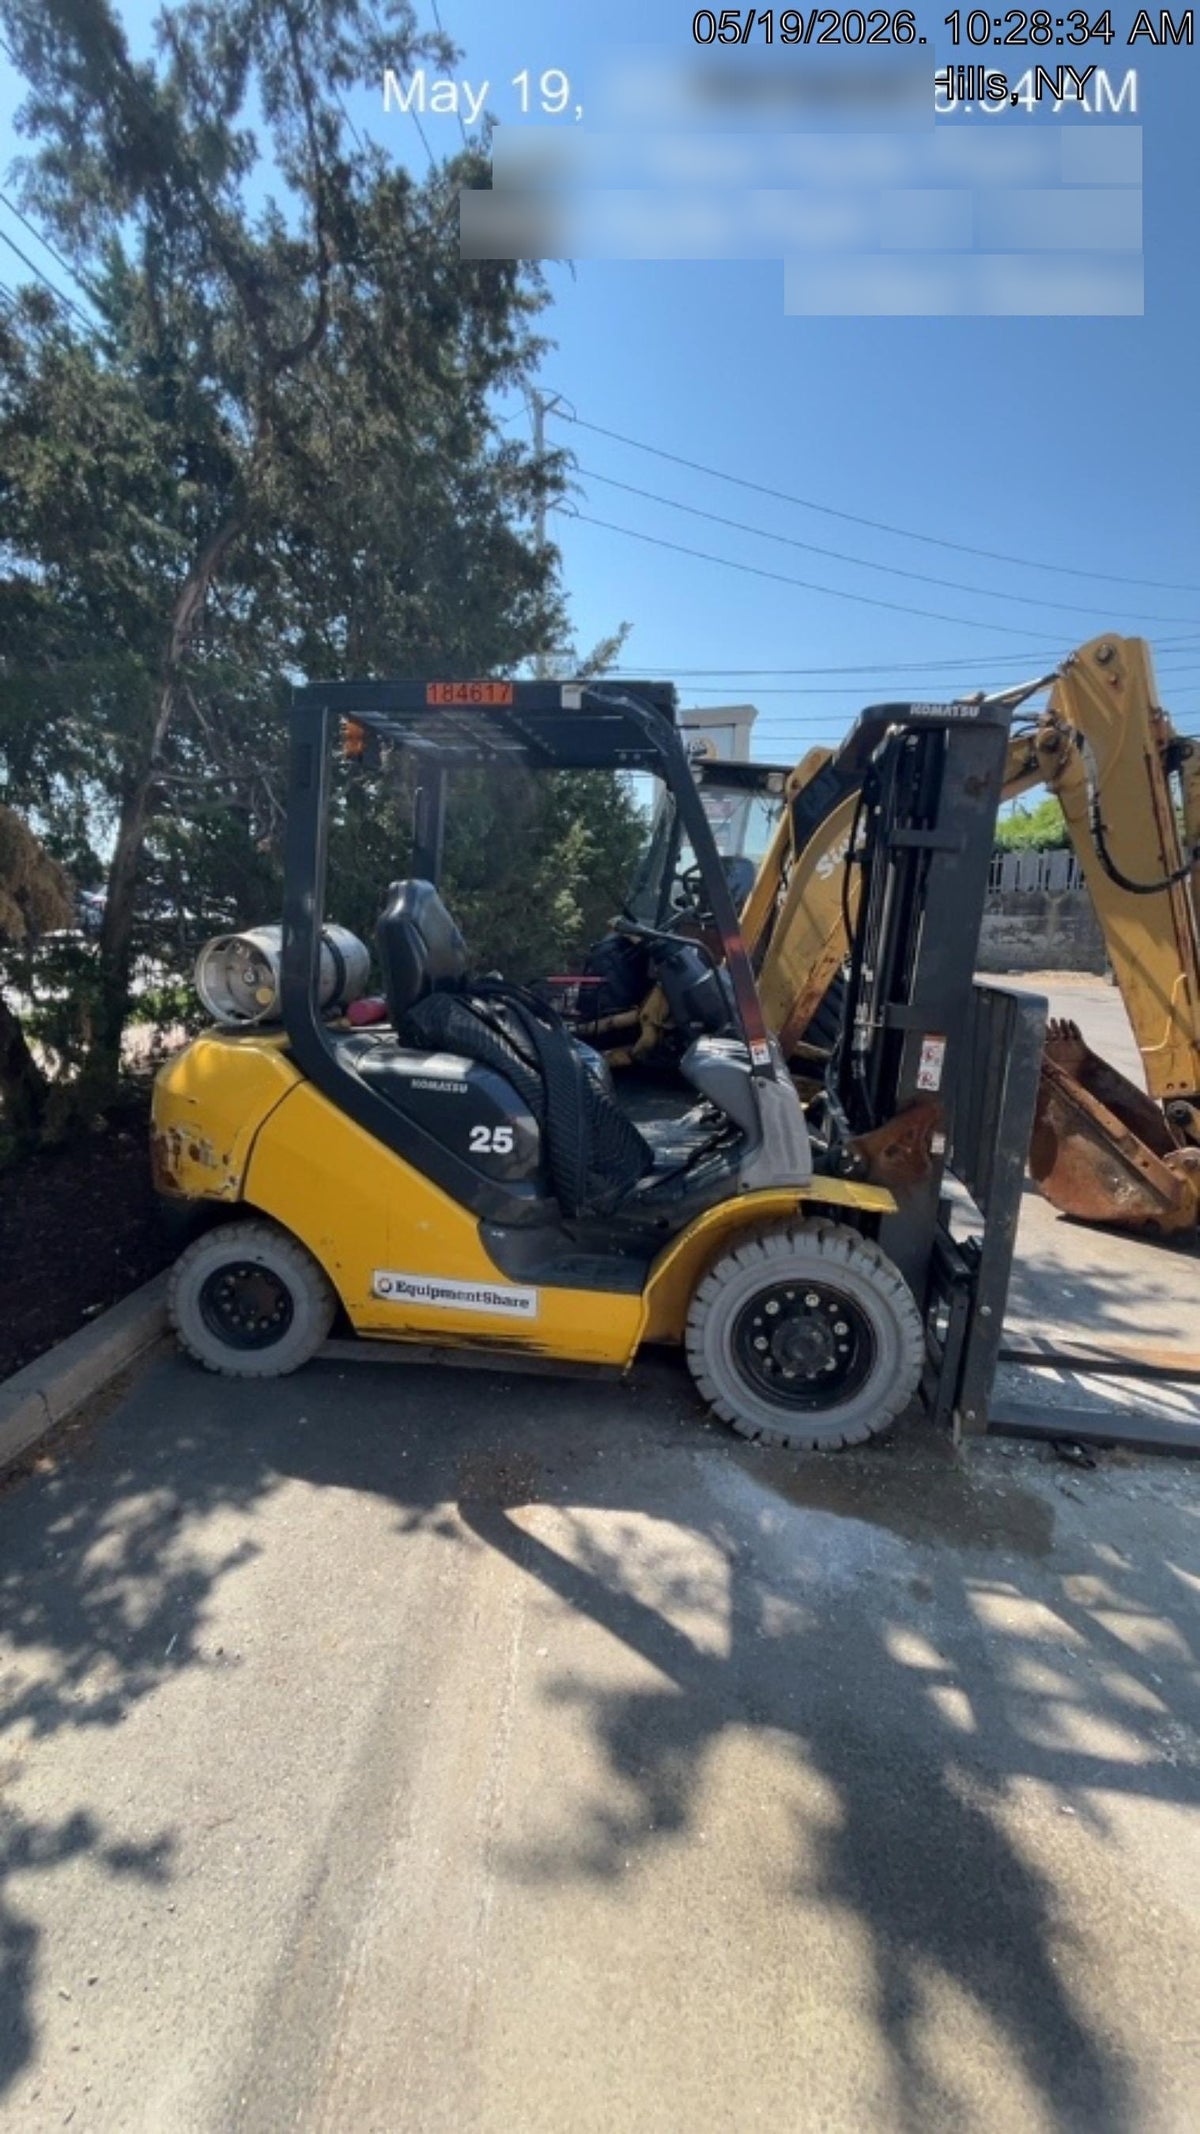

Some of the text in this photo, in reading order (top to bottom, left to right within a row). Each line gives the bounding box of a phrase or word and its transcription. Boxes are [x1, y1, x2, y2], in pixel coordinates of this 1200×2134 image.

[428, 683, 511, 702] 184617
[910, 703, 980, 718] KOMATSU
[411, 1078, 468, 1094] KOMATSU
[469, 1125, 513, 1153] 25
[395, 1280, 530, 1309] EquipmentShare
